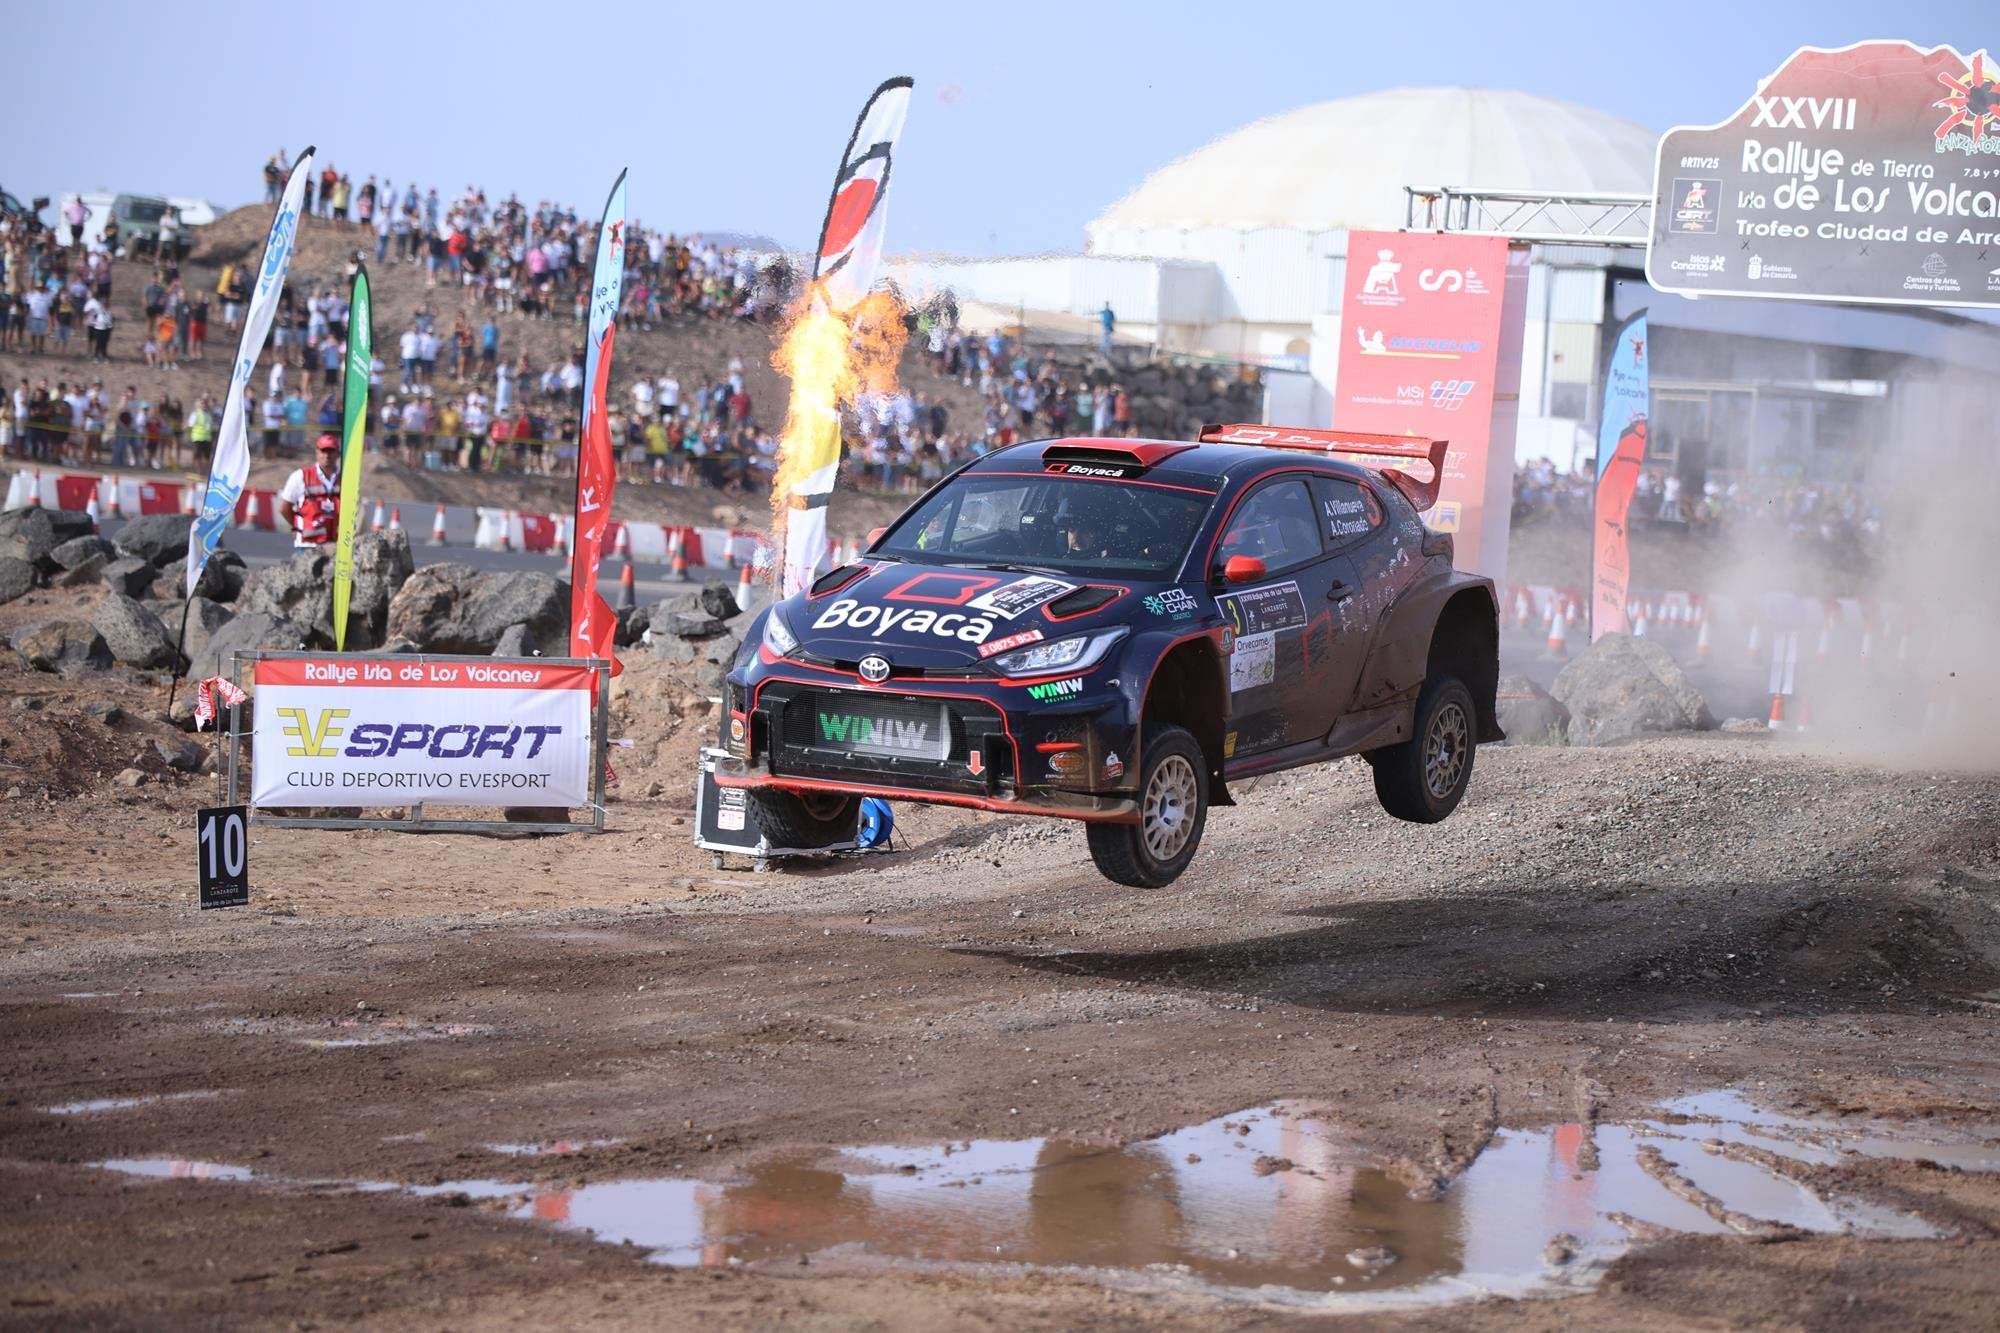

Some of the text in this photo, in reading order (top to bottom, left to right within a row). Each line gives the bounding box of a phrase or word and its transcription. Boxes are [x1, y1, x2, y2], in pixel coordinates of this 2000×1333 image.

[1750, 96, 1857, 130] XXVII
[1741, 139, 2000, 182] Rallye de Tierra 7,8 y 9
[1737, 190, 1766, 209] Isla
[1773, 177, 1820, 213] de
[1834, 178, 1891, 214] Los
[1735, 219, 1810, 239] Trofeo
[1816, 221, 1908, 243] Ciudad
[1915, 225, 1949, 245] de
[1906, 275, 1933, 284] Centros
[1934, 276, 1943, 285] de
[1934, 284, 1961, 292] Turismo
[1066, 464, 1125, 478] Boyacá
[1330, 515, 1369, 536] A.Coronado
[1158, 587, 1194, 603] COOL
[1165, 599, 1198, 614] CHAIN
[811, 598, 1000, 645] Boyacá
[304, 663, 542, 684] Rallye Isla de Los Volcanes
[1027, 677, 1083, 700] WINIW
[818, 711, 928, 751] WINIW
[286, 771, 551, 789] CLUB DEPORTIVO EVESPORT
[201, 813, 245, 879] 10
